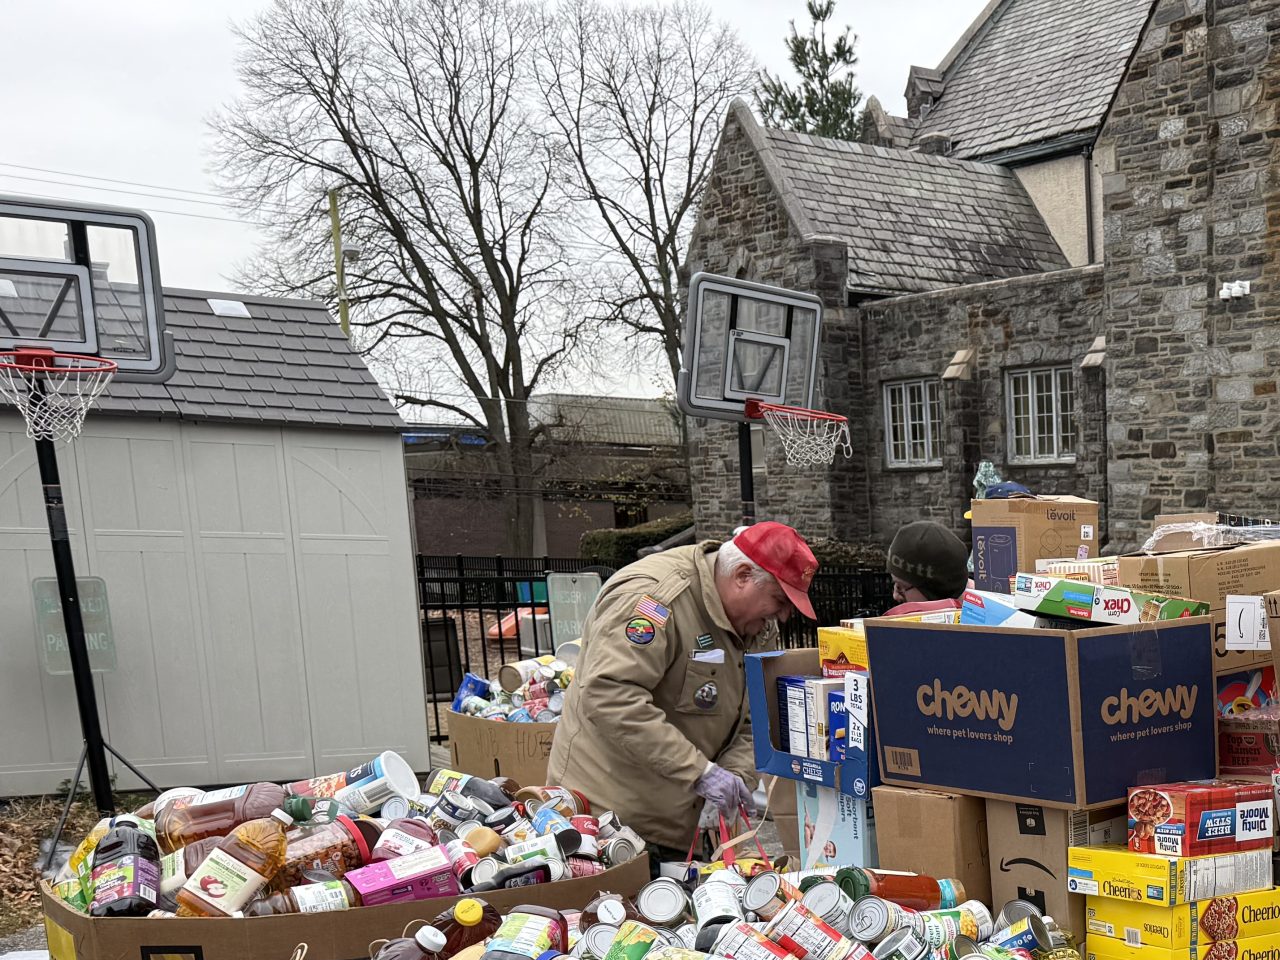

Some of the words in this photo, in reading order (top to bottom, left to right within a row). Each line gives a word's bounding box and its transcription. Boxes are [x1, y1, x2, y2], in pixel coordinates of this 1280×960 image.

[1104, 598, 1130, 613] Chex
[46, 633, 108, 651] PAING
[853, 679, 859, 692] 3
[850, 691, 863, 704] LBS
[916, 678, 1018, 731] chewy
[1101, 684, 1198, 725] chewy
[927, 725, 951, 738] where
[952, 729, 966, 741] pet
[967, 729, 992, 741] lovers
[993, 732, 1013, 744] shop
[1110, 731, 1135, 743] where
[1136, 728, 1150, 739] pet
[1151, 724, 1173, 736] lovers
[1174, 721, 1192, 732] shop
[851, 736, 862, 744] BAGS
[1227, 735, 1243, 747] Top
[1227, 744, 1261, 755] Ramen
[802, 767, 823, 777] CHEESE
[1239, 806, 1270, 819] Moore
[1205, 816, 1231, 828] STEW
[1242, 819, 1268, 832] Dinty
[1205, 825, 1231, 836] BEEF
[1157, 836, 1179, 844] Moore
[1159, 843, 1179, 853] Dinty
[1103, 880, 1142, 900] Cheerios
[1144, 922, 1169, 938] Cheerios
